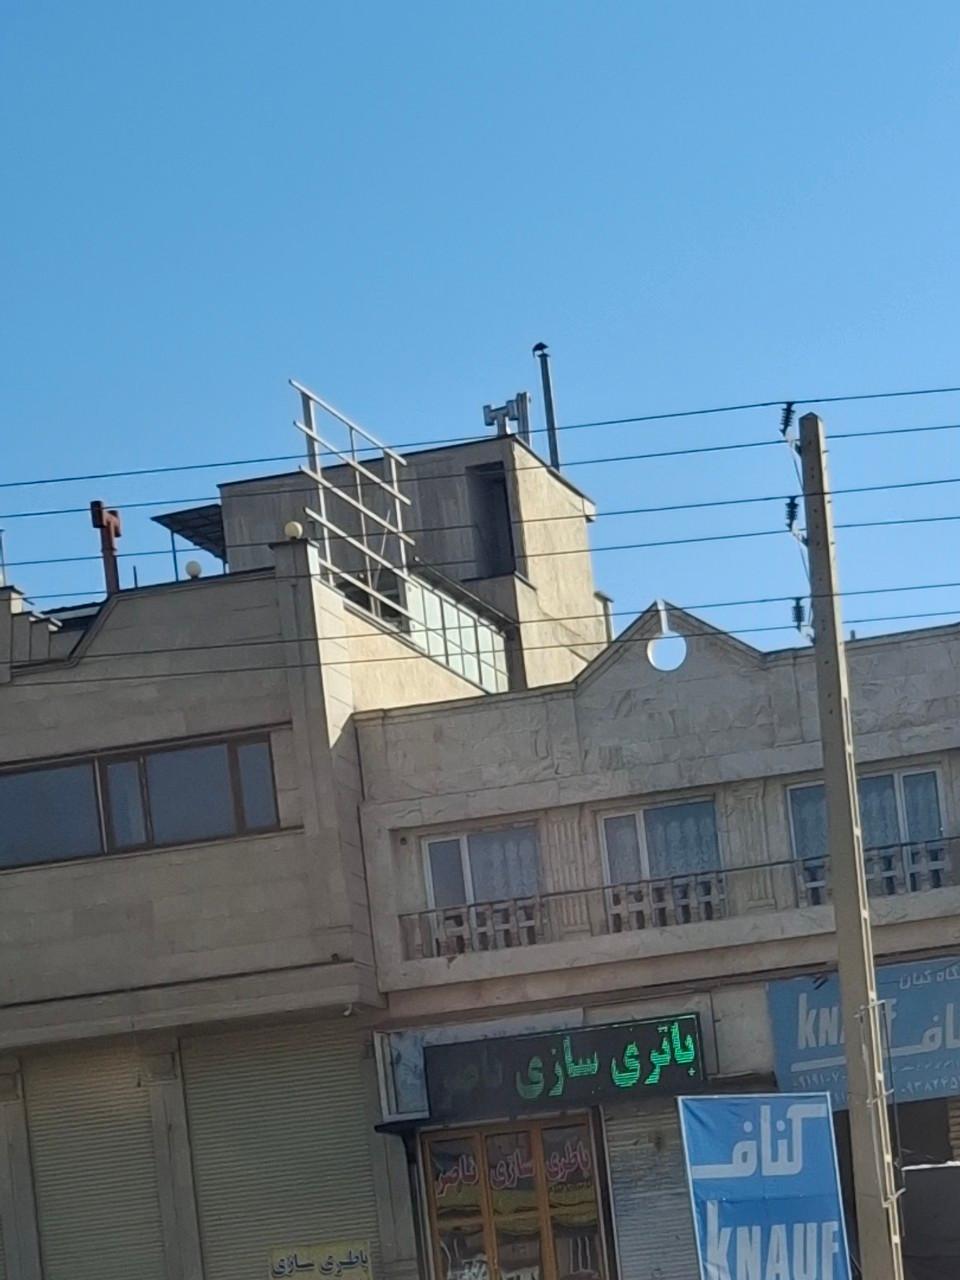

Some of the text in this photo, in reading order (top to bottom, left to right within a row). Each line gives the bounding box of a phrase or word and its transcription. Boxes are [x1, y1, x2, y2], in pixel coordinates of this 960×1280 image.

[797, 992, 897, 1050] KNF
[516, 1036, 599, 1099] سازی
[611, 1021, 695, 1087] باتری
[490, 1149, 535, 1190] سازی
[691, 1103, 828, 1179] کناف
[436, 1154, 479, 1198] ناصر
[272, 1248, 369, 1277] باطری سازی
